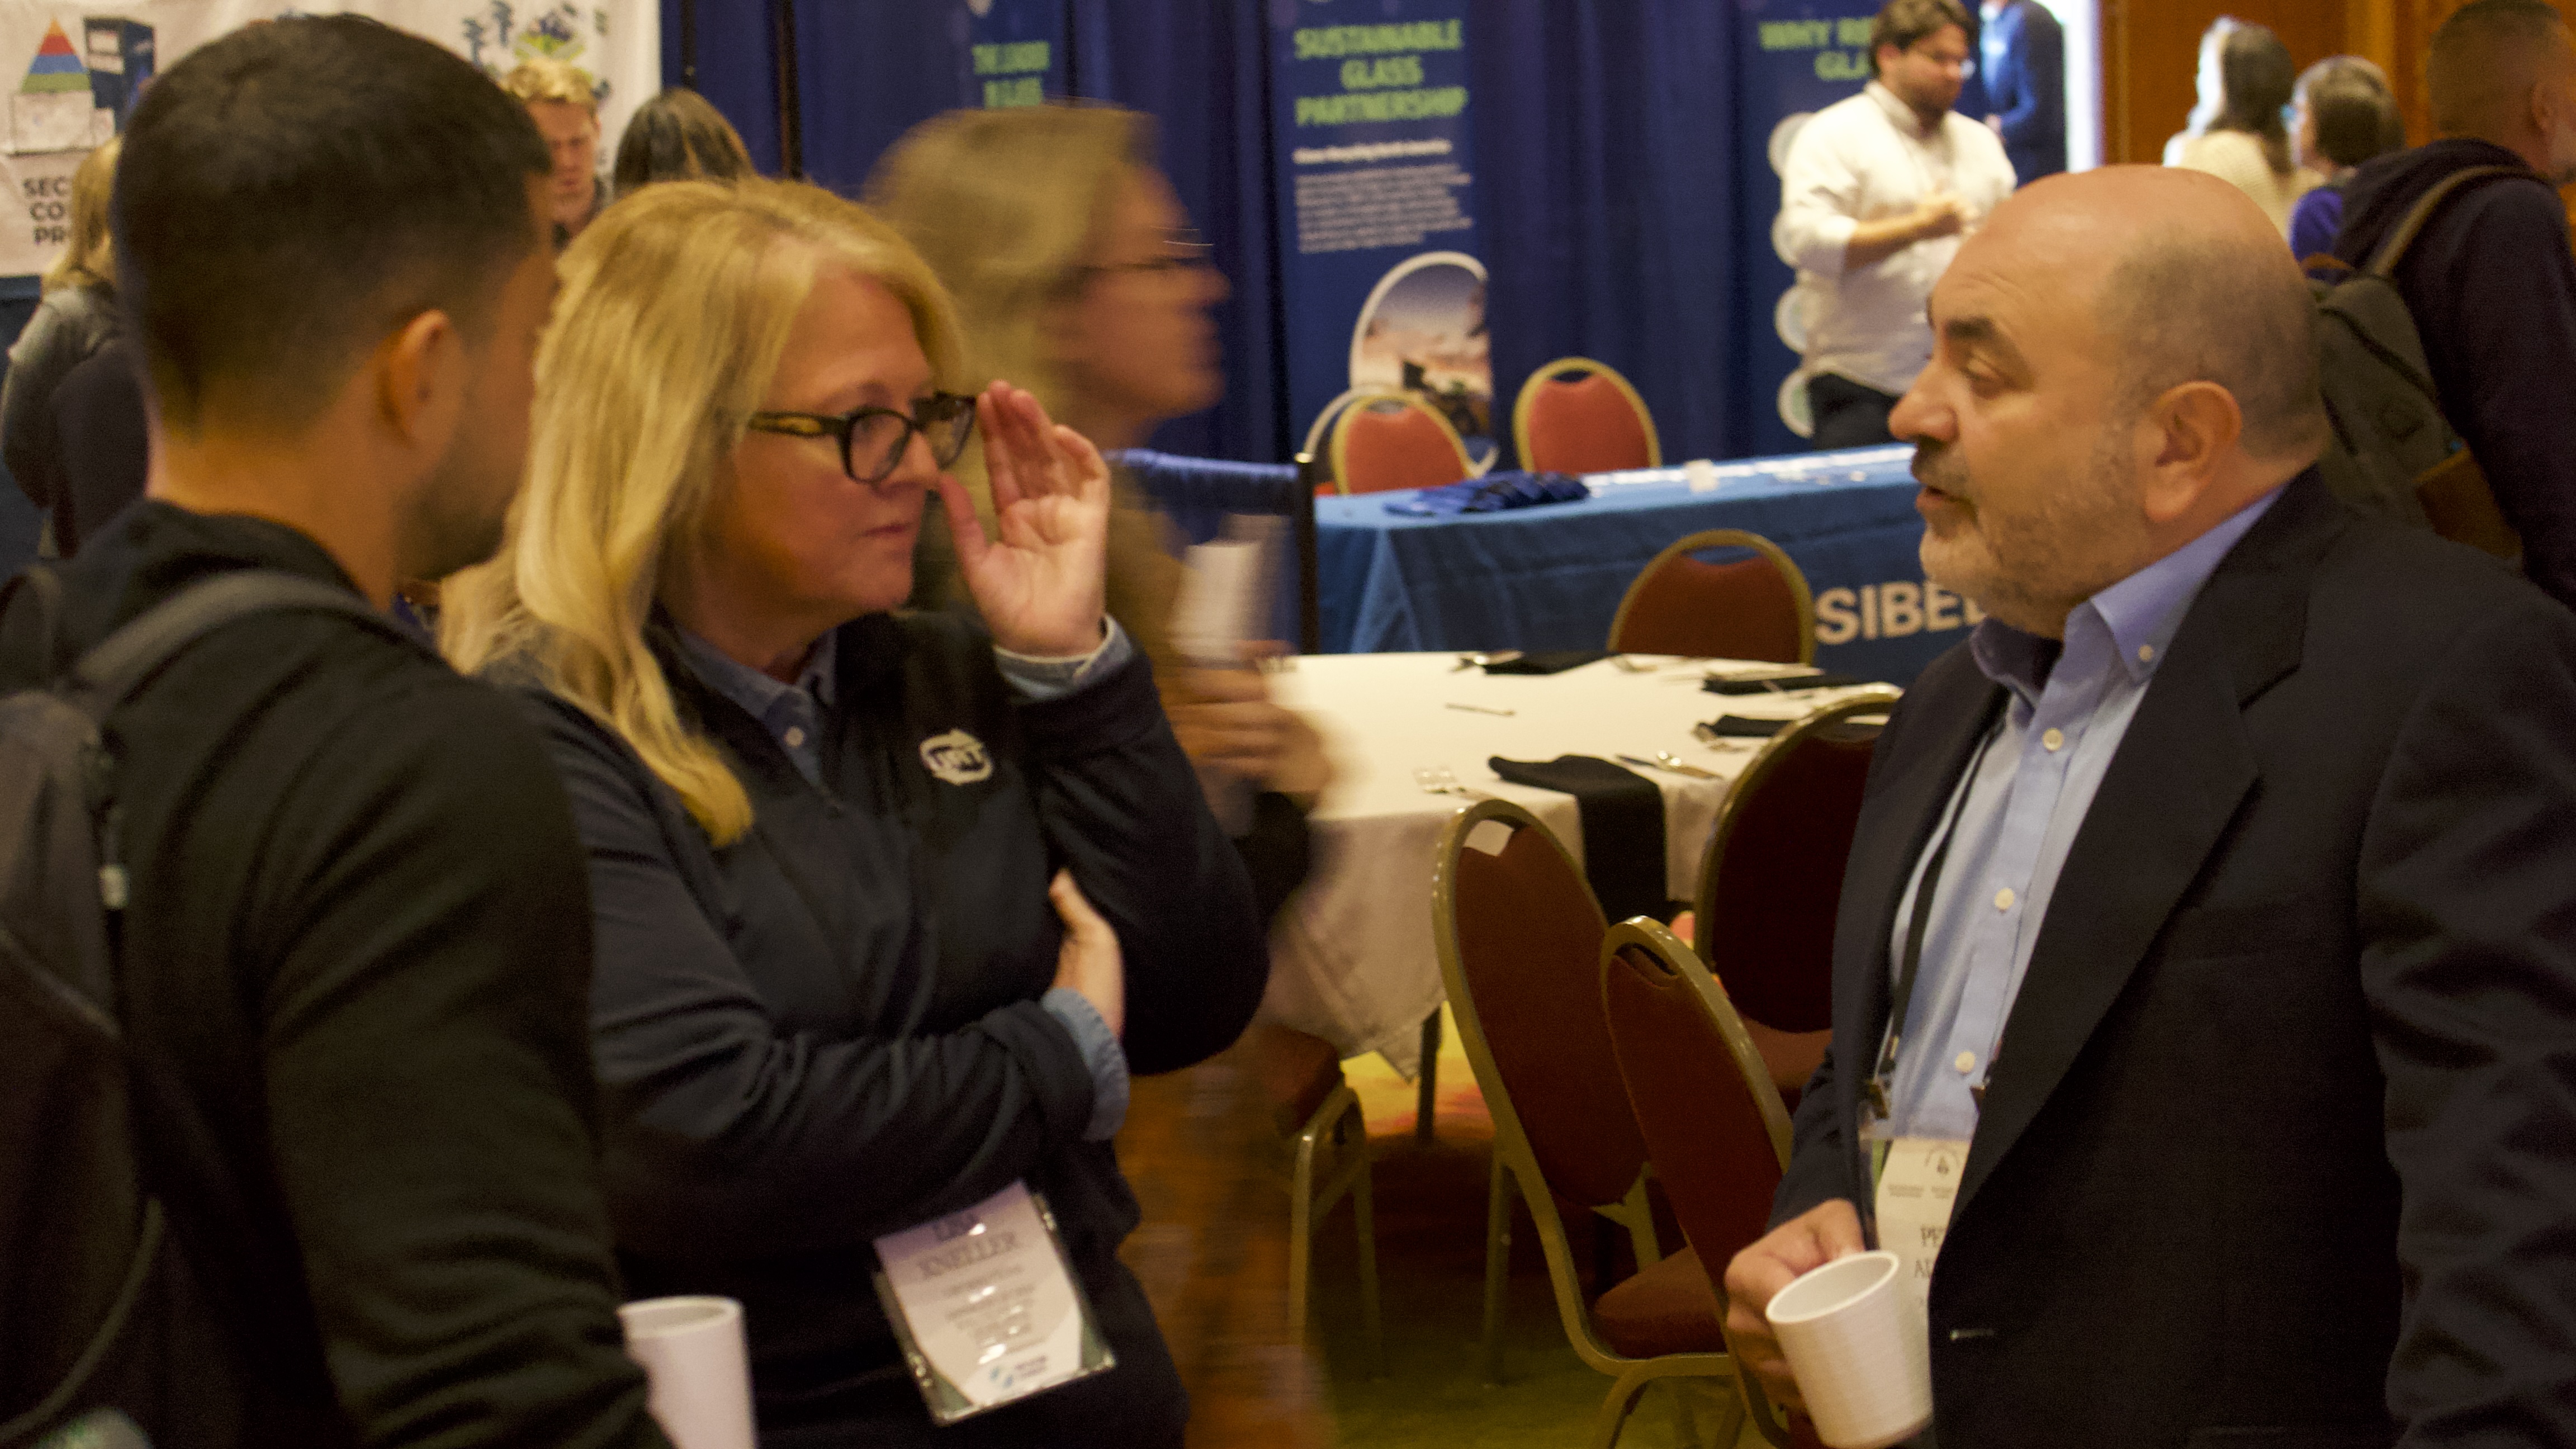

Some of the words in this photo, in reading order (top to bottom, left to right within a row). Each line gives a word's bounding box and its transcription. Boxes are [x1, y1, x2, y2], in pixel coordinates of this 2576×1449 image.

[1294, 20, 1461, 60] SUSTAINABLE
[1340, 56, 1424, 89] GLASS
[1295, 87, 1469, 126] PARTNERSHIP
